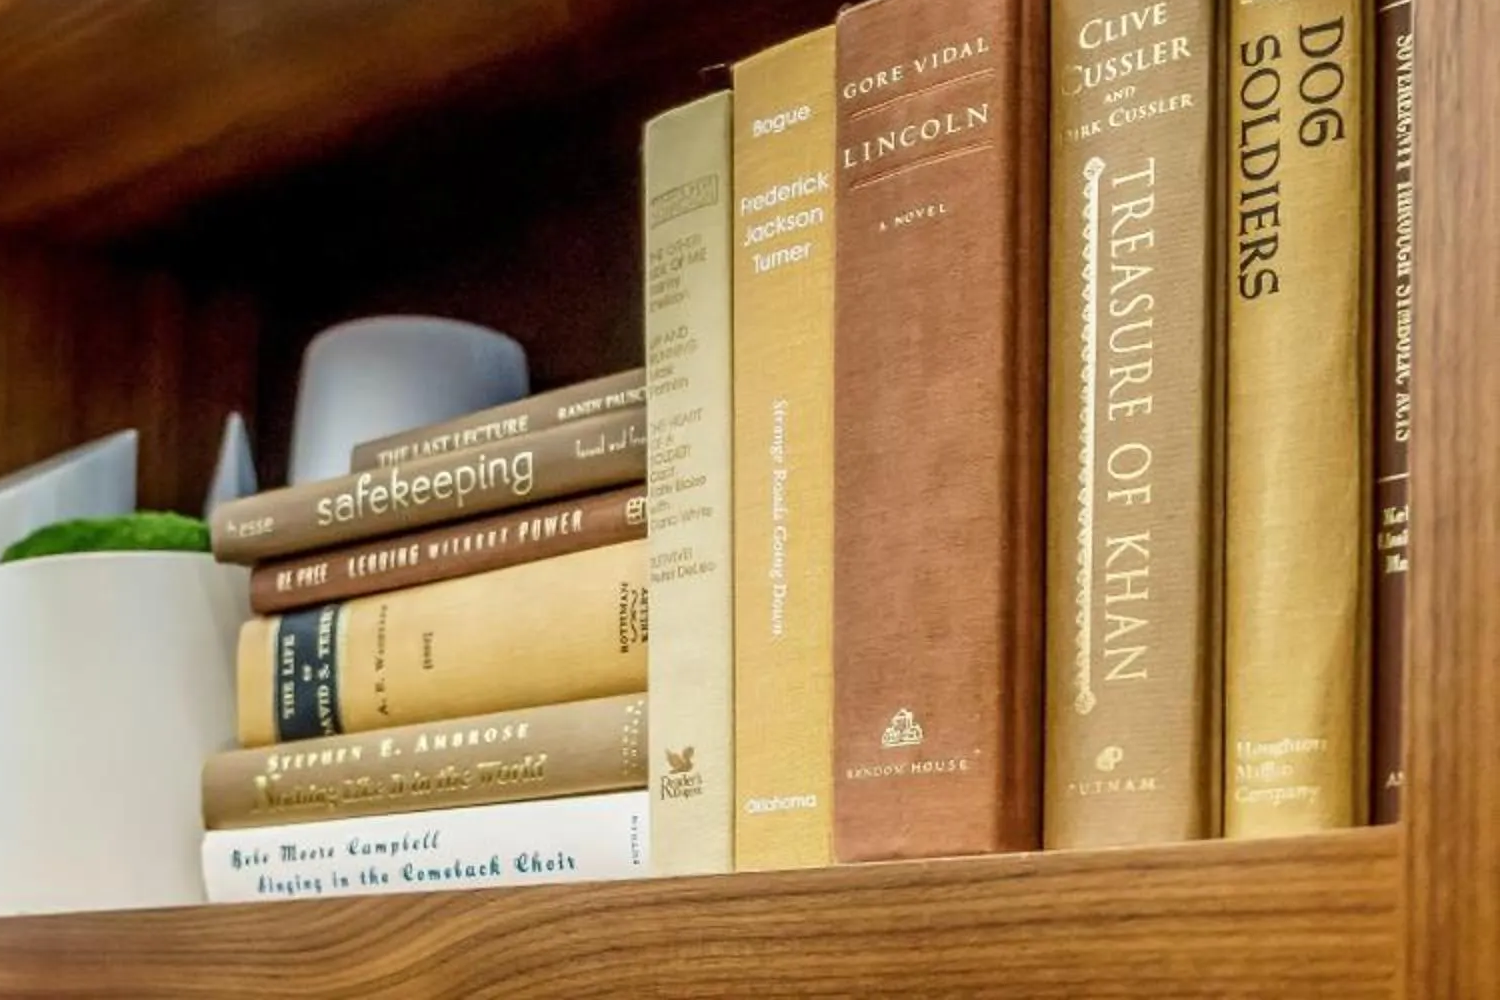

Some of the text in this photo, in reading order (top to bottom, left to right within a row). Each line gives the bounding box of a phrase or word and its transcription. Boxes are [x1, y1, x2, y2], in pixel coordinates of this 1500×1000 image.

[1079, 2, 1168, 50] CLIVE
[843, 37, 989, 100] GORE VIDAL
[1061, 36, 1191, 96] CUSSLER
[1299, 15, 1346, 148] DOG
[1104, 85, 1136, 104] AND
[1108, 93, 1195, 128] CUSSLER
[753, 105, 811, 137] Bogue
[843, 103, 989, 169] LINCOLN
[1238, 34, 1282, 301] SOLDIERS
[741, 171, 829, 216] Frederick
[894, 203, 947, 227] NOVEL
[744, 206, 824, 247] Jackson
[753, 241, 812, 273] Turner
[1104, 157, 1156, 681] TREASURE OF KHAN
[316, 451, 533, 527] safekeeping
[348, 544, 419, 578] LEADING
[428, 526, 509, 560] WITHOUT
[518, 509, 583, 543] POWER
[281, 633, 296, 720] THE LIFE
[266, 722, 529, 774] STEPHEN E. AMBROSE
[476, 753, 548, 786] World
[911, 759, 967, 775] HOUSE
[348, 829, 441, 857] Campbell
[332, 871, 350, 889] in
[359, 865, 389, 886] the
[402, 853, 501, 882] Comeback
[514, 850, 576, 874] Choir
